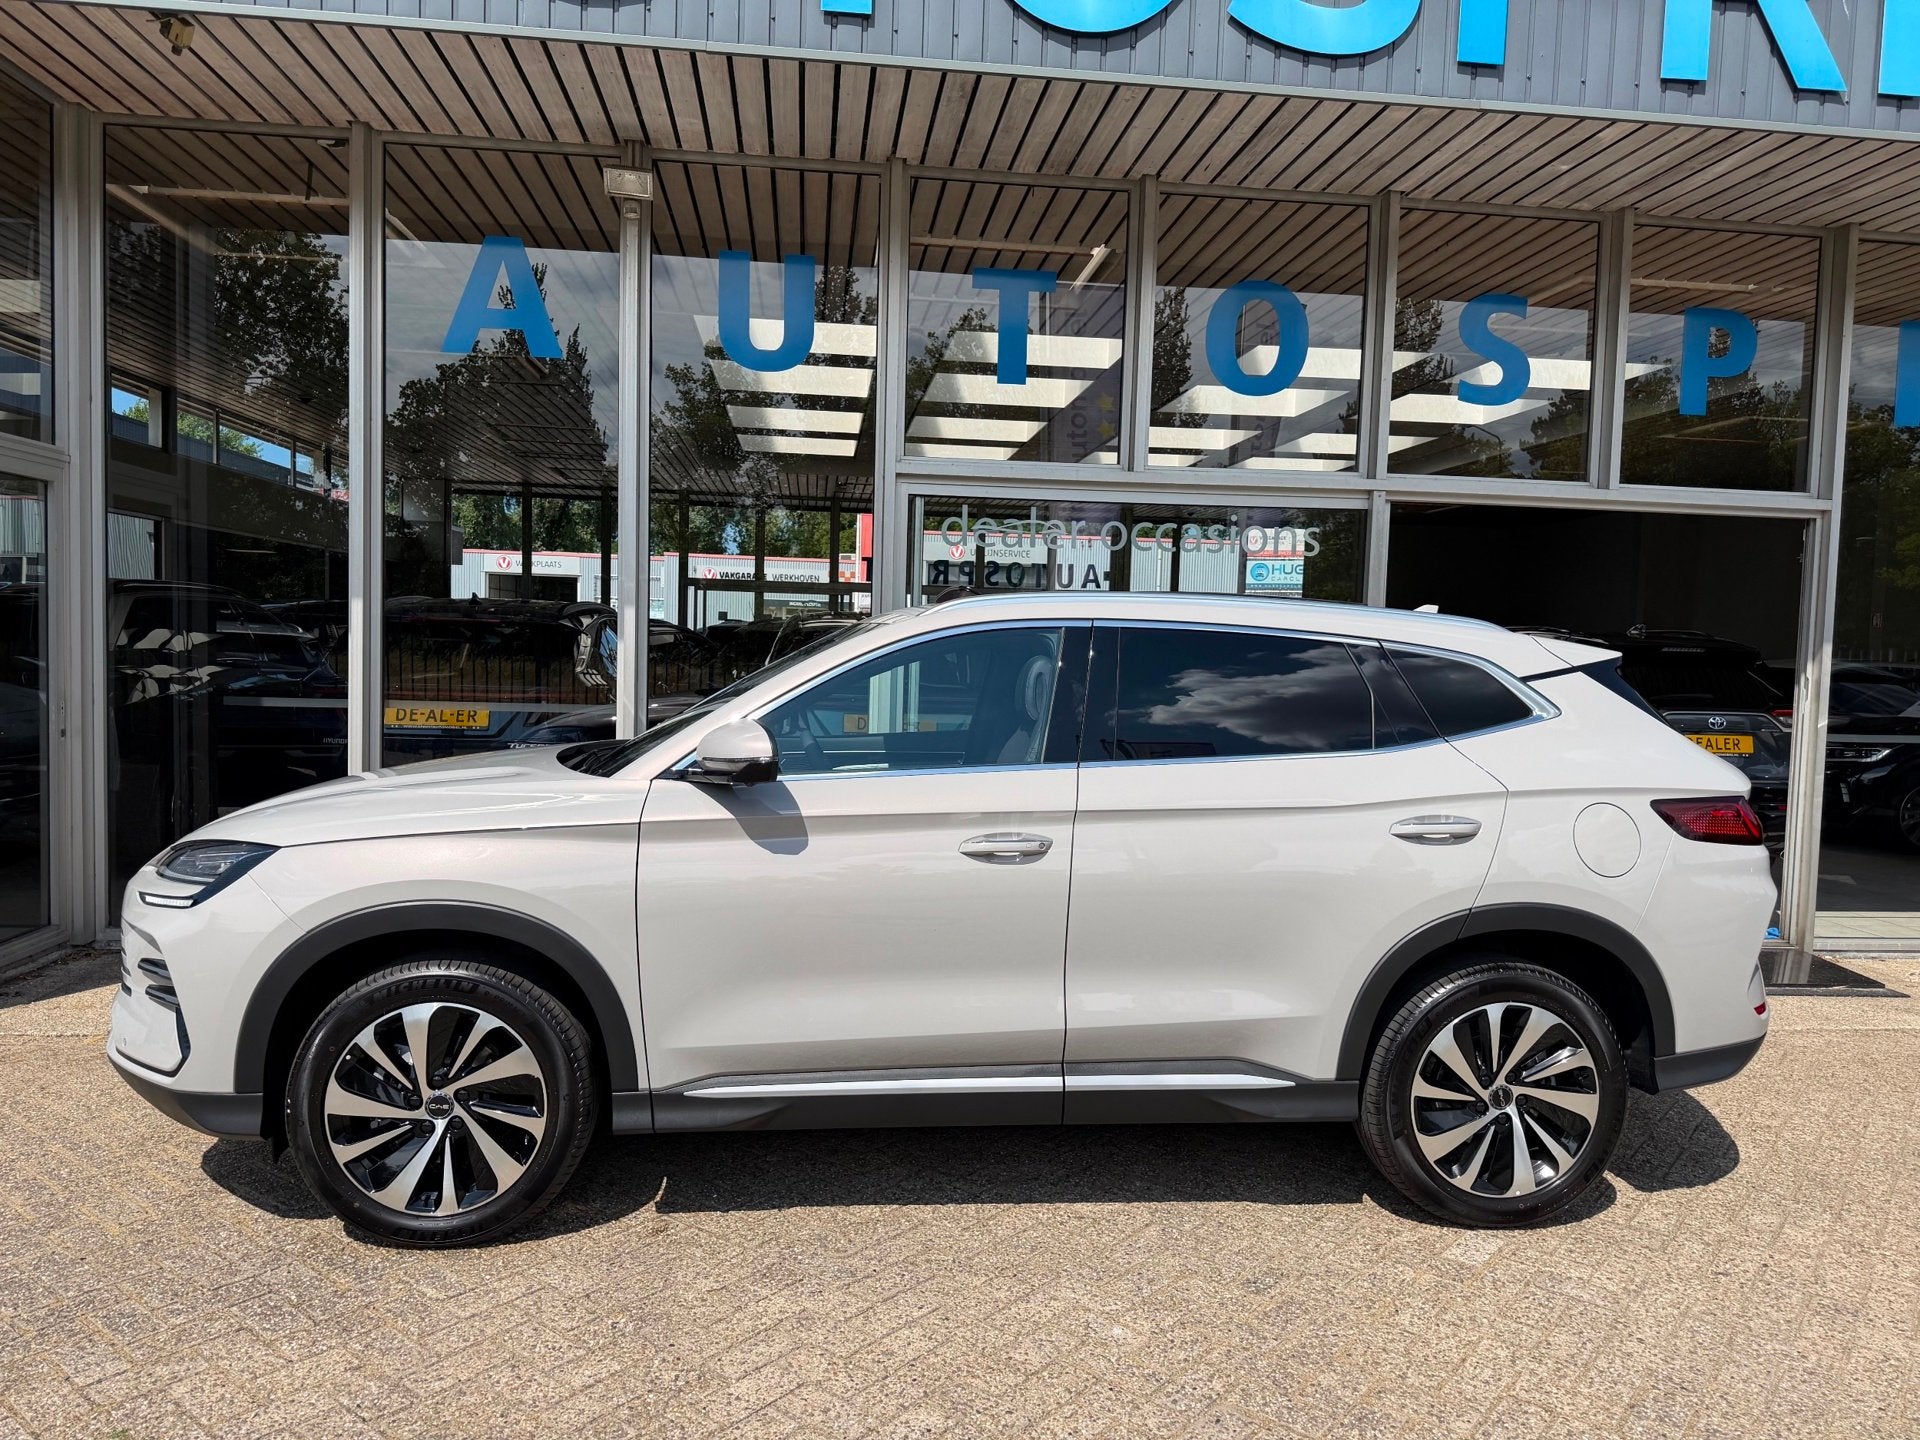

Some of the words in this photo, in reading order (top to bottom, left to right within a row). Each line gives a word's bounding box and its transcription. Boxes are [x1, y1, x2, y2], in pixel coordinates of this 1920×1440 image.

[940, 504, 1087, 549] dealer
[1100, 514, 1321, 557] occasions
[514, 559, 562, 568] WKPLAATS
[1688, 737, 1741, 750] EALER
[372, 978, 475, 999] MICHELIN
